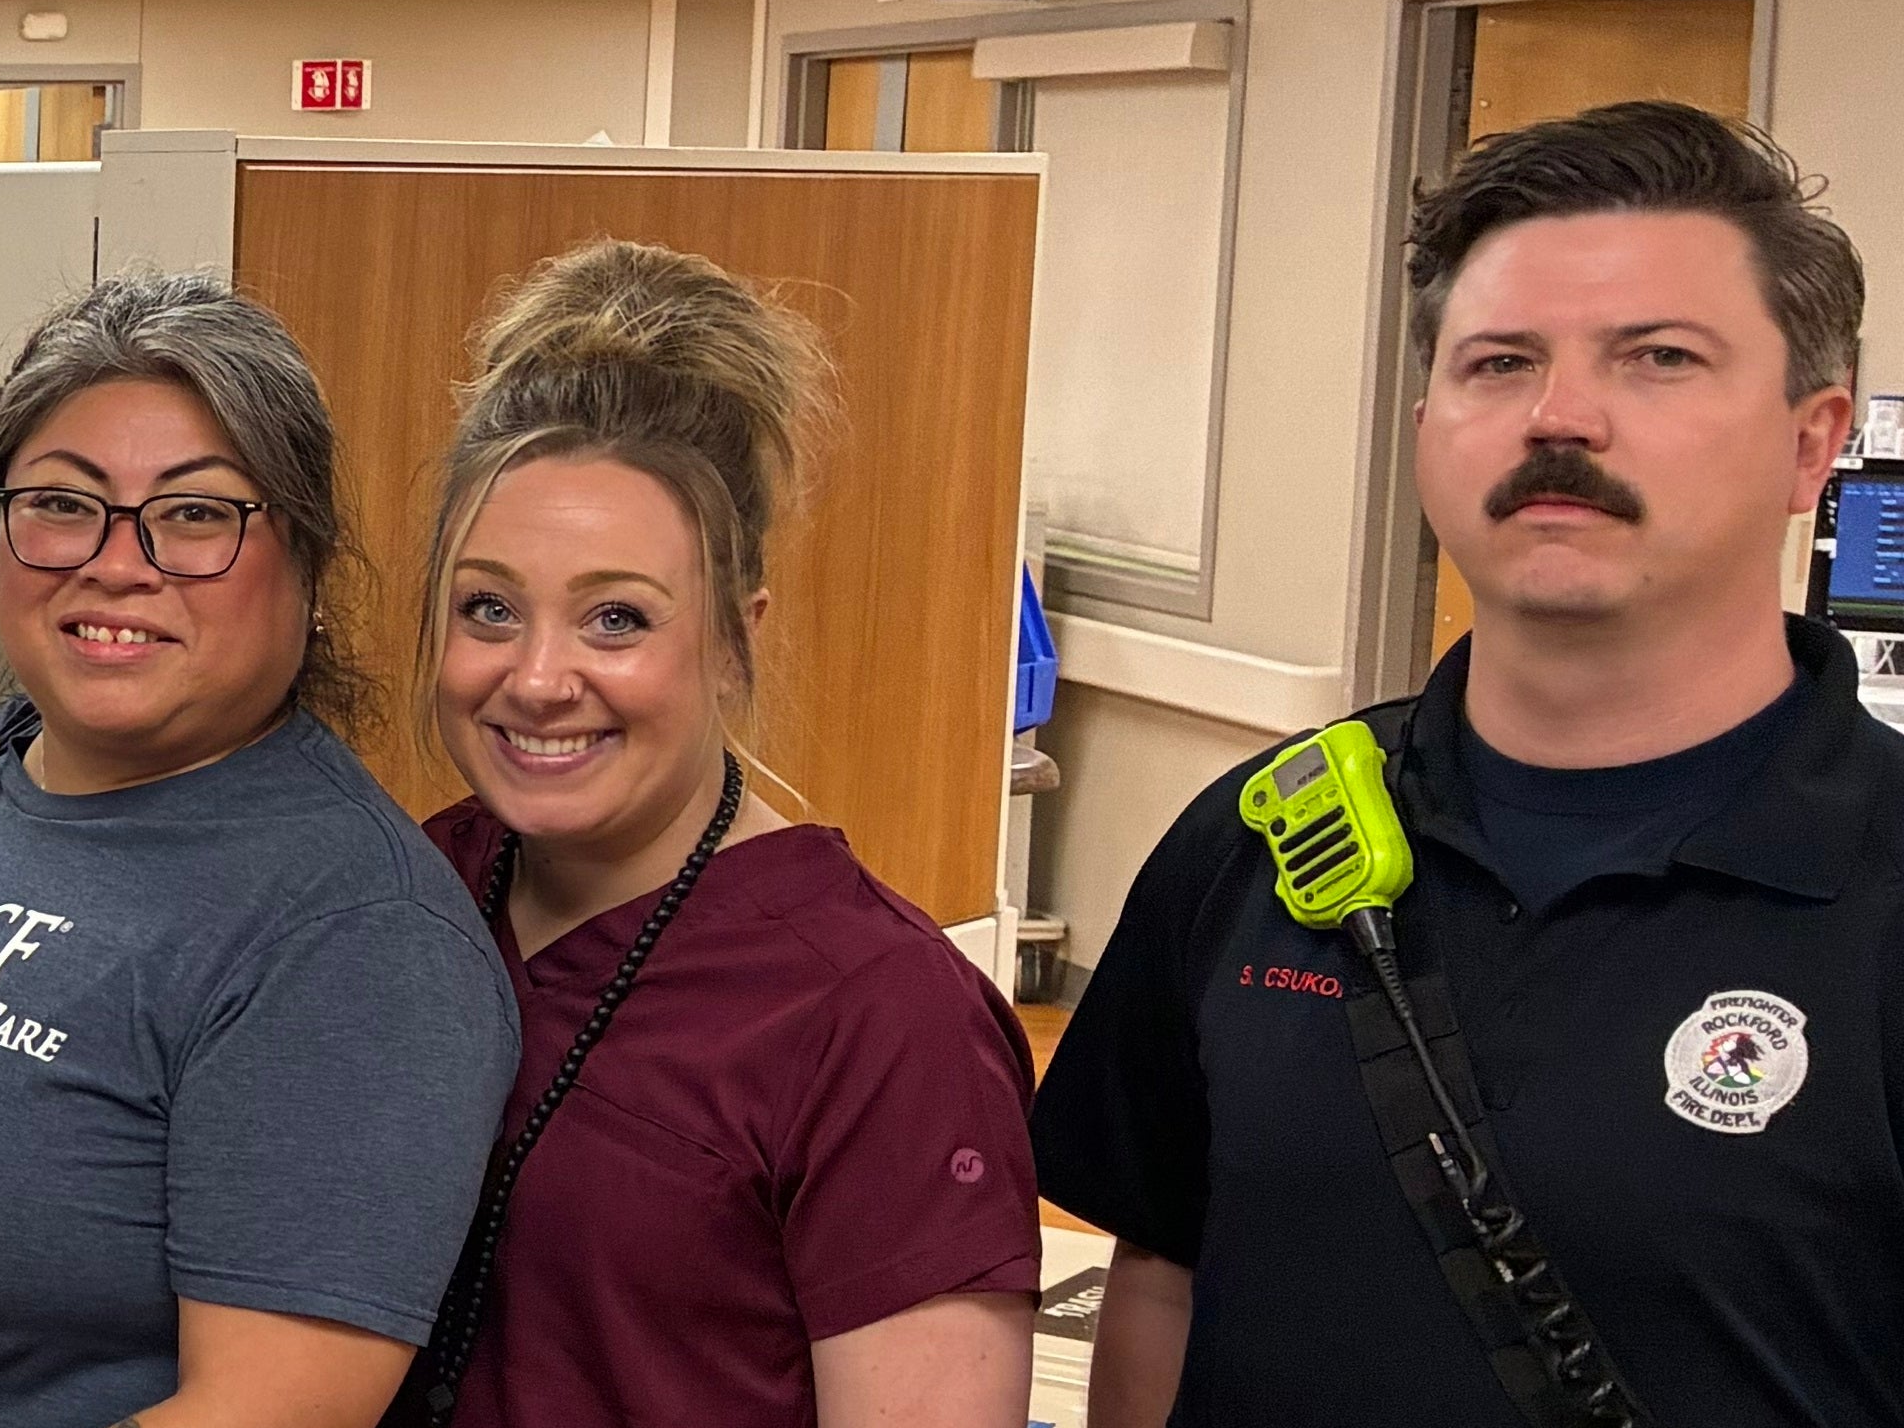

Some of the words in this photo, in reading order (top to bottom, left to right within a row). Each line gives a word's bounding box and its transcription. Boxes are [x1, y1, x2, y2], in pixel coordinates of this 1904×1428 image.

[1710, 996, 1800, 1030] FIREFIGHTER
[1700, 1011, 1789, 1052] ROCKFORD
[1672, 1089, 1711, 1122] FIRE
[1688, 1075, 1759, 1107] ILLINOIS
